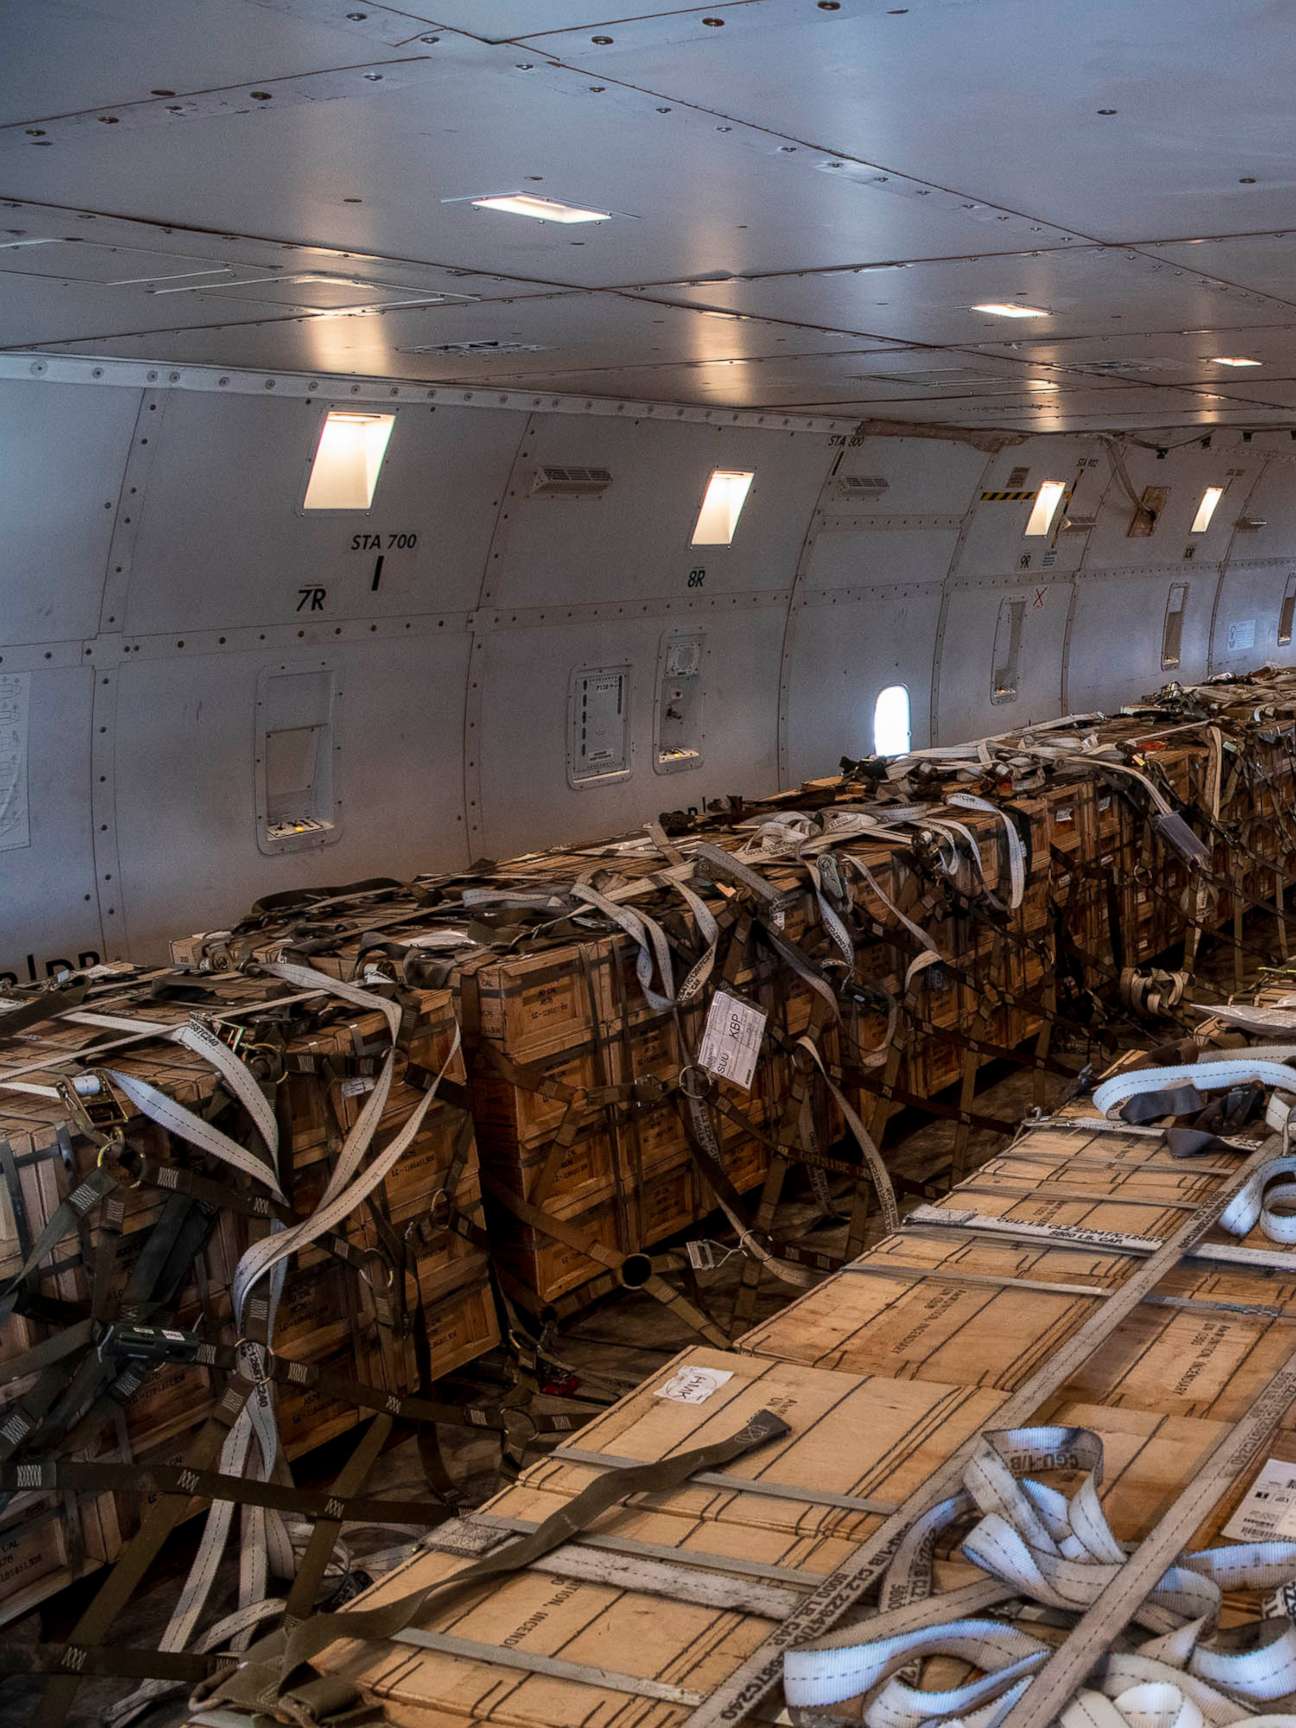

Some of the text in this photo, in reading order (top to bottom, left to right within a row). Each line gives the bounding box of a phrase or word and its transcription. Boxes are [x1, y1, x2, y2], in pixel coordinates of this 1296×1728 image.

[351, 534, 417, 550] STA 700
[687, 570, 705, 587] 8R
[296, 588, 326, 611] 7R
